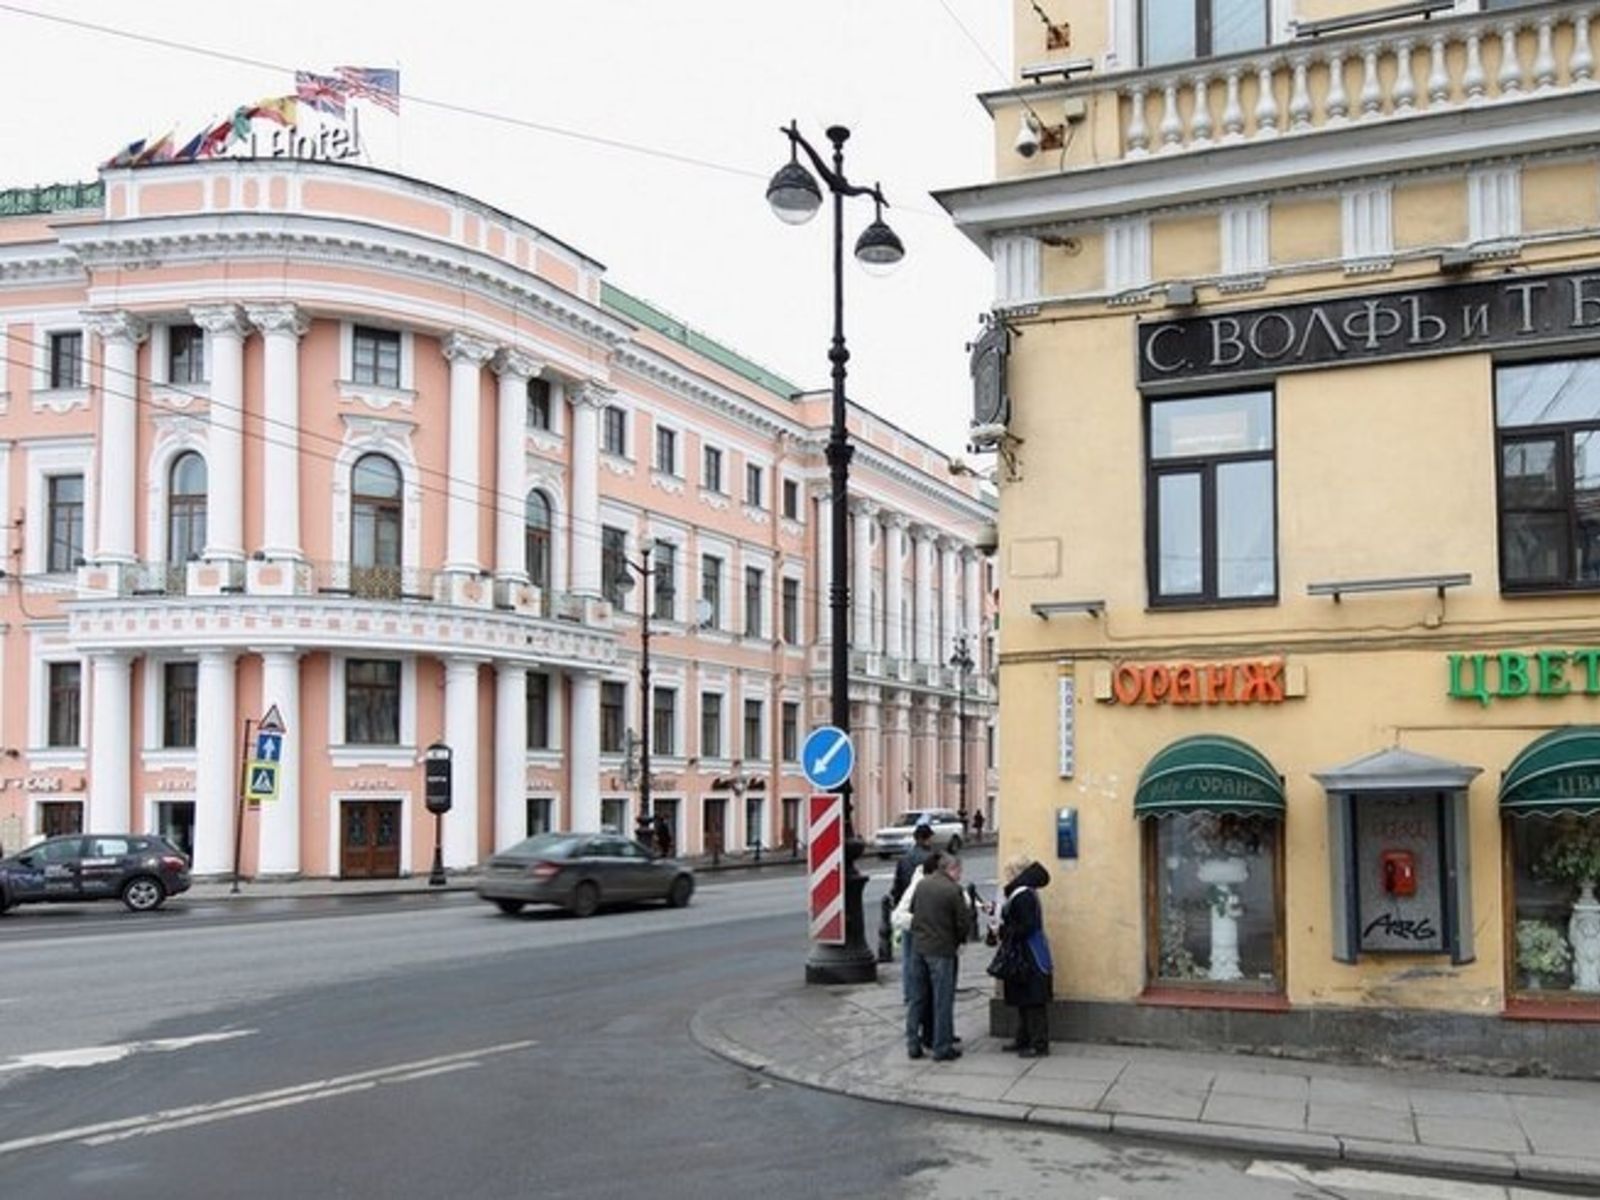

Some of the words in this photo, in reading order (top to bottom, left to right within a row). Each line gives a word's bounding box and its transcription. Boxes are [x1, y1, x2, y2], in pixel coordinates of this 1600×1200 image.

[272, 106, 361, 160] Hotel
[1208, 295, 1447, 367] ВОЛФЪ
[1113, 660, 1286, 705] ОРАНЖ
[1447, 648, 1600, 707] ЦВЕТ
